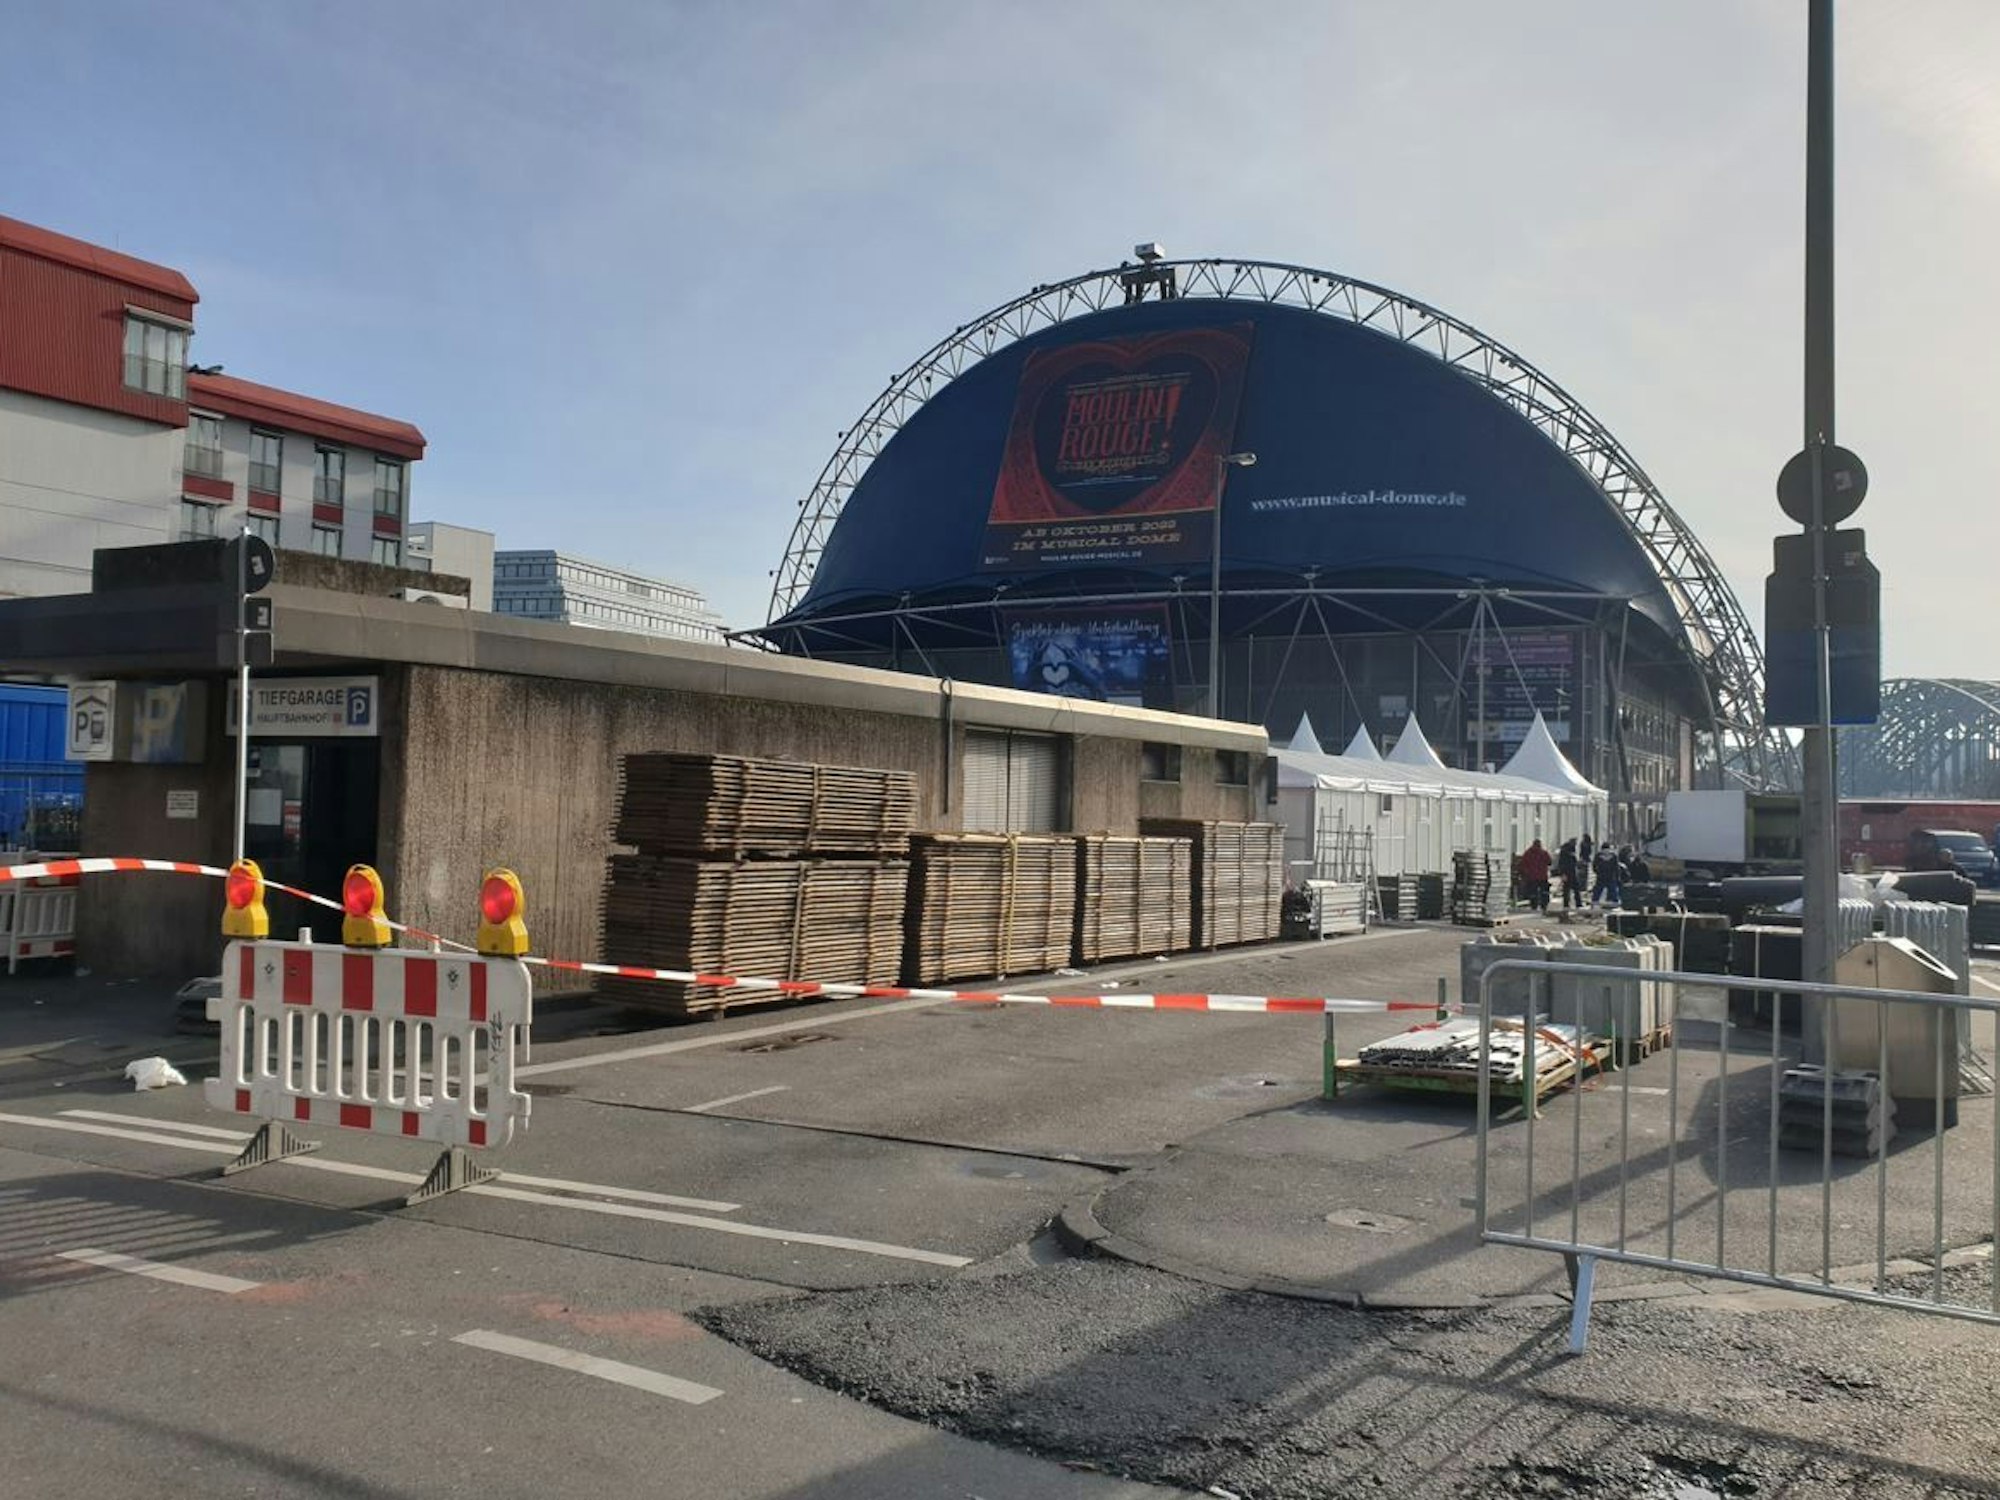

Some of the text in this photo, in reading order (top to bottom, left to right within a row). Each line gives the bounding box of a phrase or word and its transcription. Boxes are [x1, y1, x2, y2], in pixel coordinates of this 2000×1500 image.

[1065, 384, 1166, 427] MOULIN
[1251, 489, 1467, 510] www.musical-dome.de
[1022, 528, 1047, 538] AB
[1050, 525, 1136, 537] OKTOBER
[1012, 533, 1181, 551] IM MUSICAL DOME
[258, 689, 344, 705] TIEFGARAGE
[256, 712, 329, 724] HAUPTBAHNHOF
[352, 697, 366, 722] P
[75, 711, 89, 742] P
